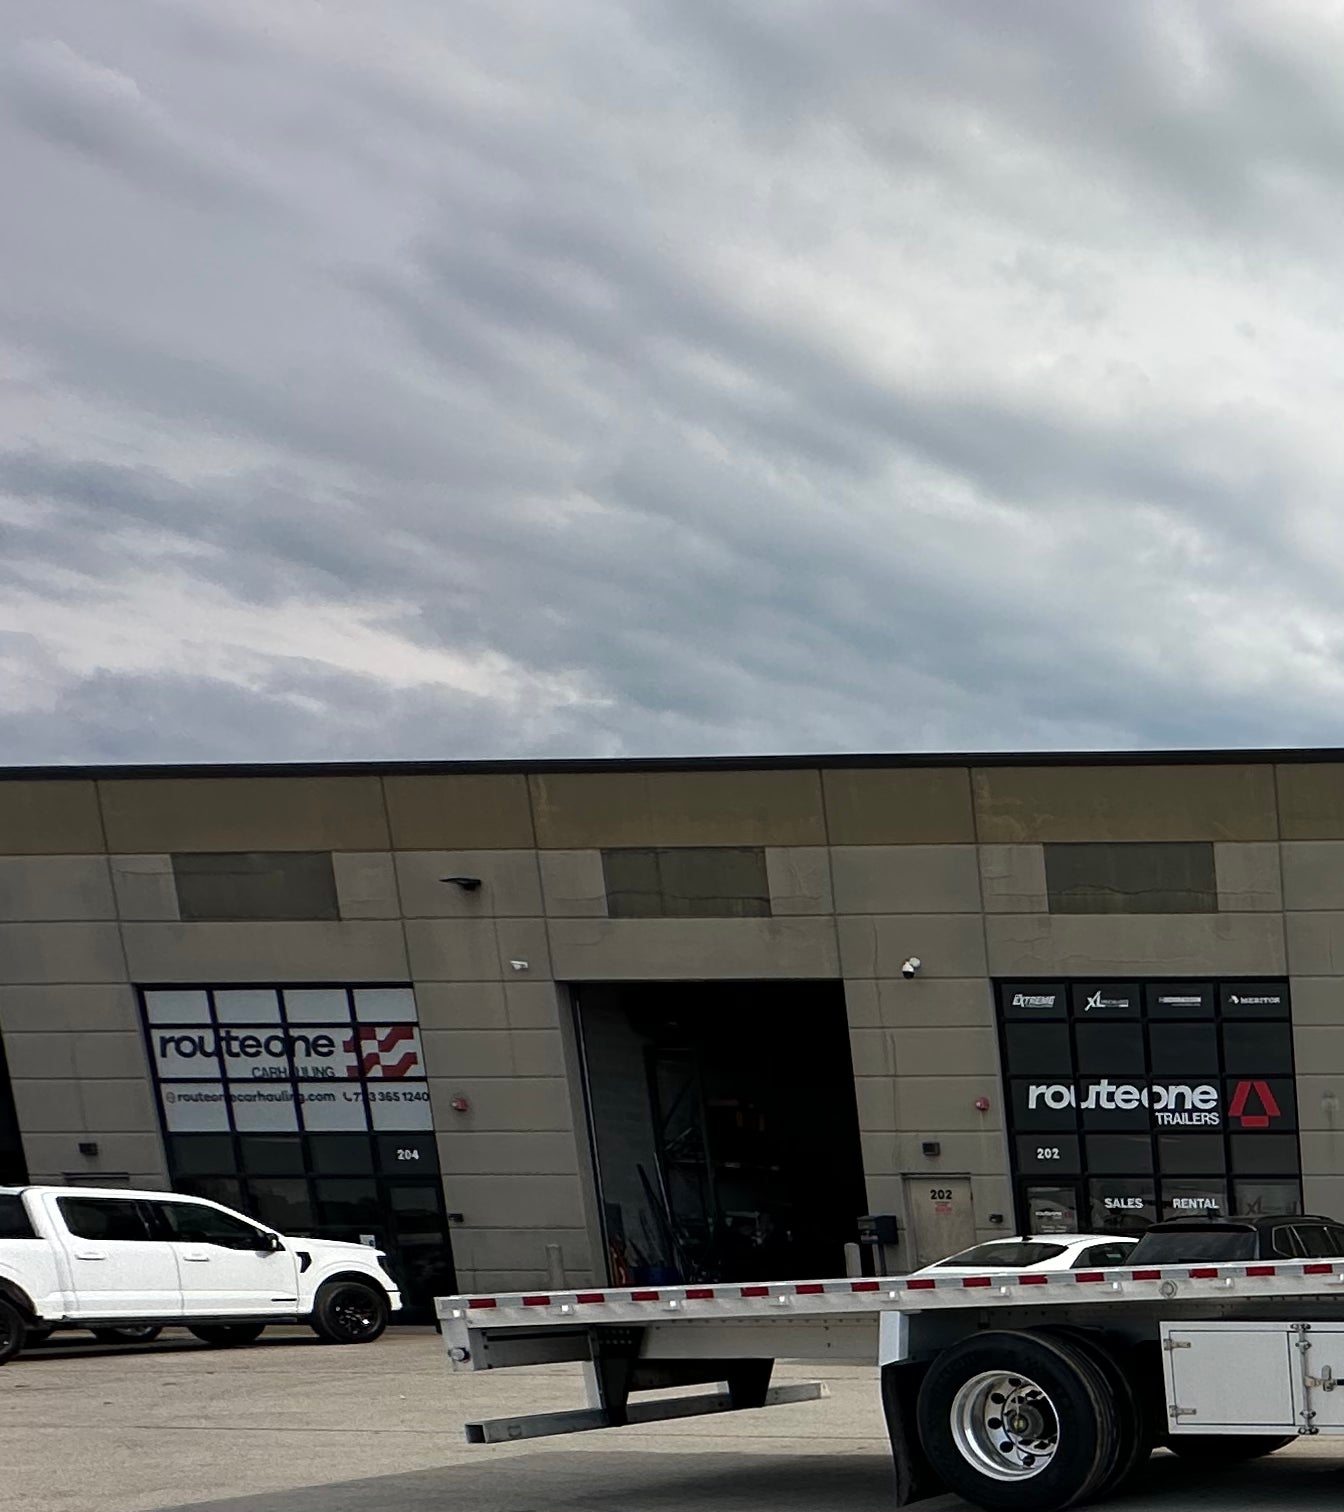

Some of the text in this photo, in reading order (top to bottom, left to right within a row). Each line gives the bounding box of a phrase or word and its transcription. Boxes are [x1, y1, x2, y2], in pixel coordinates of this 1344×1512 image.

[159, 1029, 336, 1059] routeone
[1028, 1079, 1218, 1110] routeone
[1155, 1112, 1220, 1126] TRAILERS
[397, 1149, 420, 1161] 204
[1036, 1147, 1061, 1160] 202
[930, 1189, 953, 1200] 202
[1104, 1197, 1144, 1210] SALES
[1172, 1197, 1220, 1210] RENTAL
